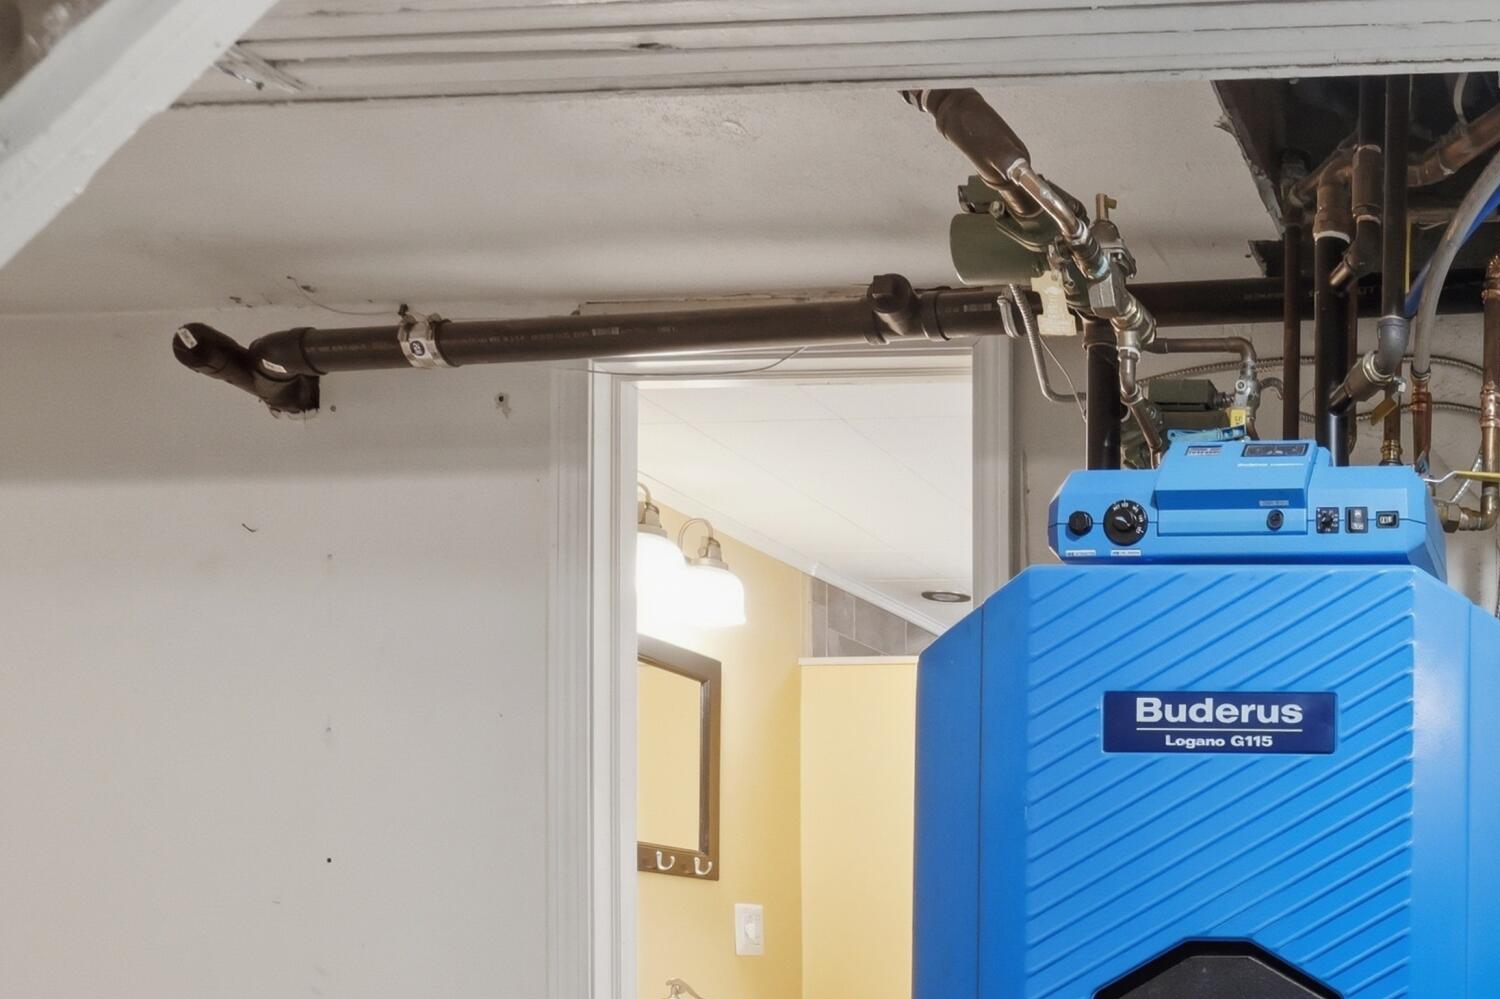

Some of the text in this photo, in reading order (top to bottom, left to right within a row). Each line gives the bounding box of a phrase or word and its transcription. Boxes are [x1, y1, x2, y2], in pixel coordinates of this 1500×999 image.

[1135, 696, 1304, 724] Buderus
[1164, 734, 1273, 749] Logano G115
